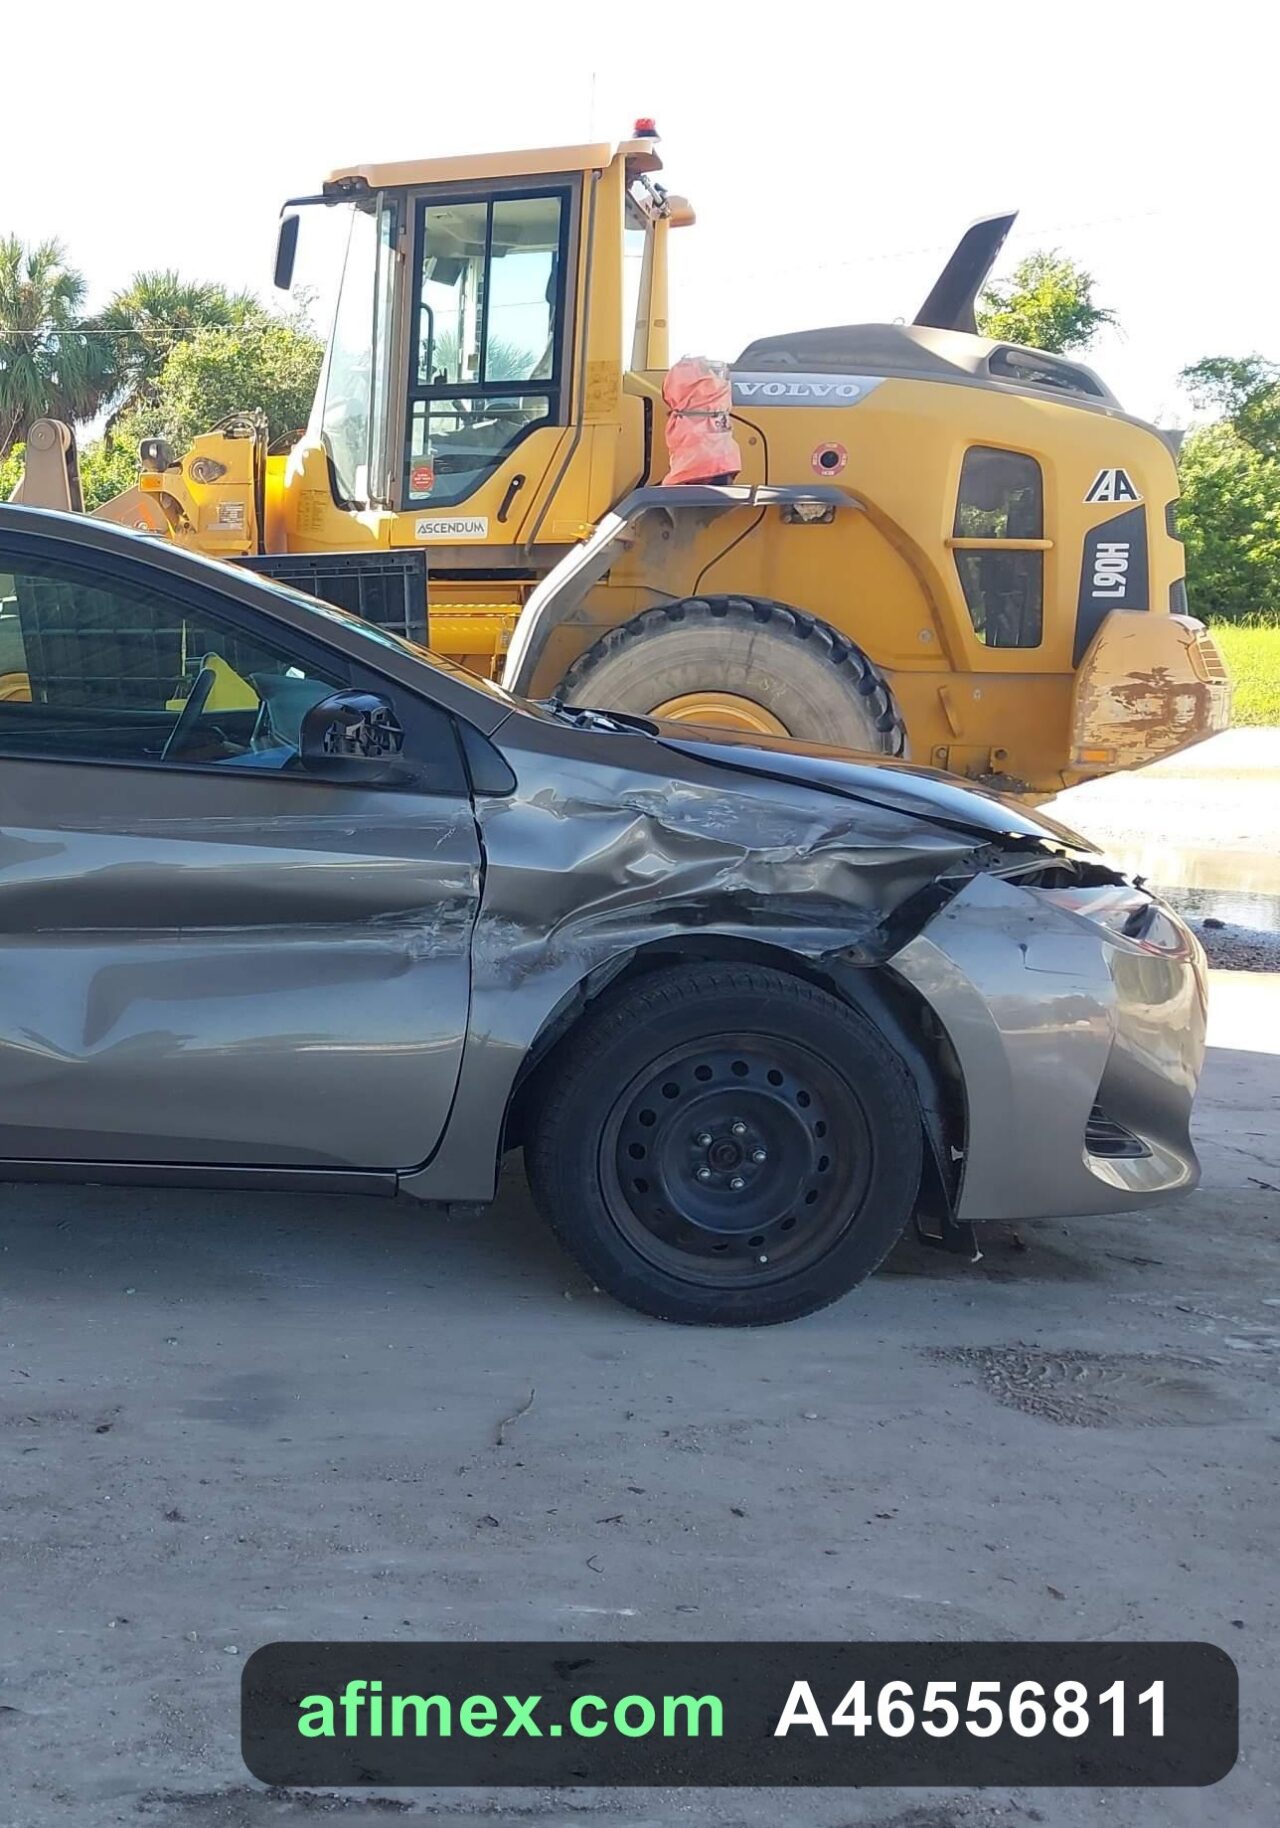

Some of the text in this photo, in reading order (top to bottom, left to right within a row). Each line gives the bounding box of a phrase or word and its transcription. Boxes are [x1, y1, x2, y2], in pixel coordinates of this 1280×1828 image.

[734, 382, 861, 398] VOLVO
[417, 521, 485, 534] ASCENDUM
[1092, 543, 1130, 598] L90H
